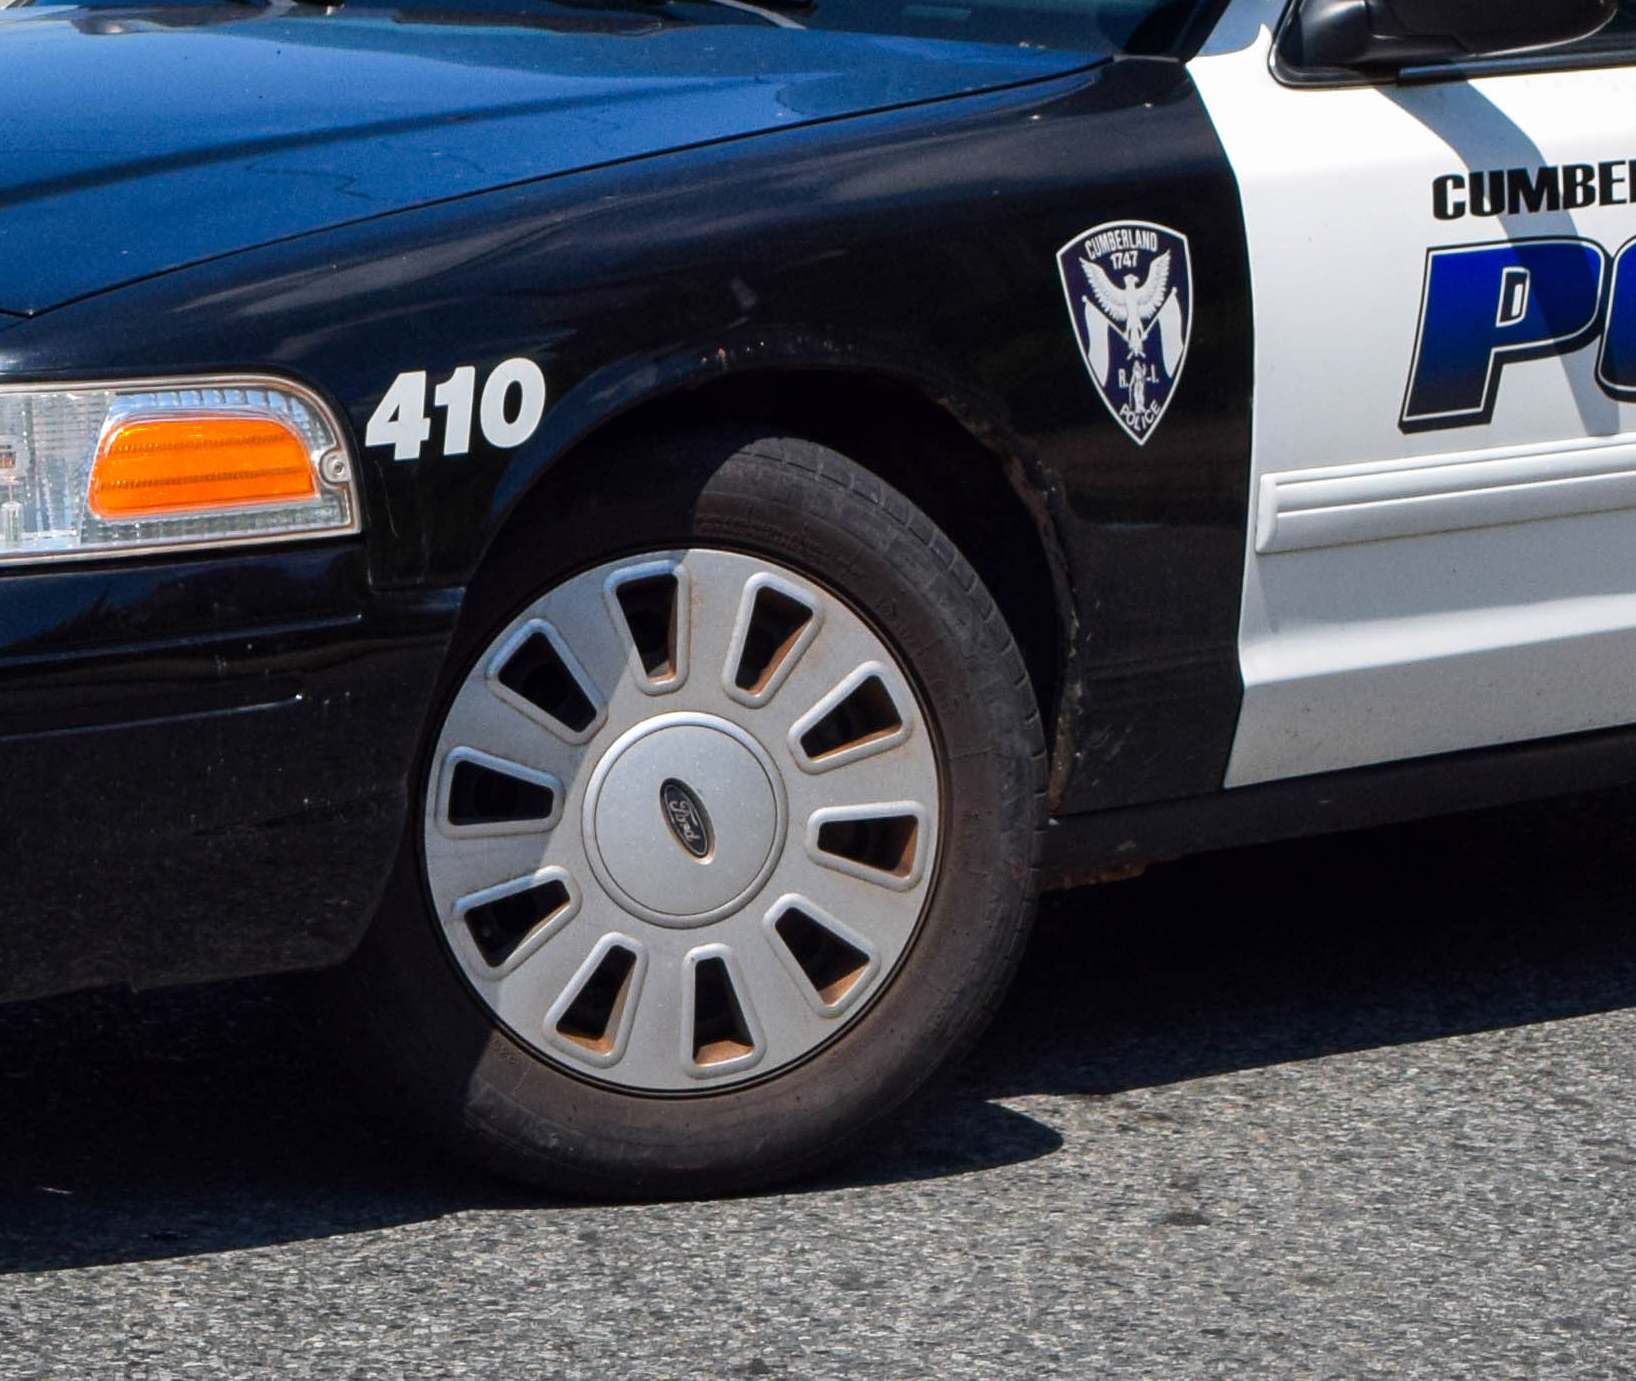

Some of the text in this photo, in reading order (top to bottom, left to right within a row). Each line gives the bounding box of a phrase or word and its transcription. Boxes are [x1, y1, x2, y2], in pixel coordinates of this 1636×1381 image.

[1084, 229, 1158, 260] CUMBERLAND
[1110, 250, 1139, 270] 1747
[365, 357, 546, 461] 410
[1118, 400, 1162, 431] POLICE
